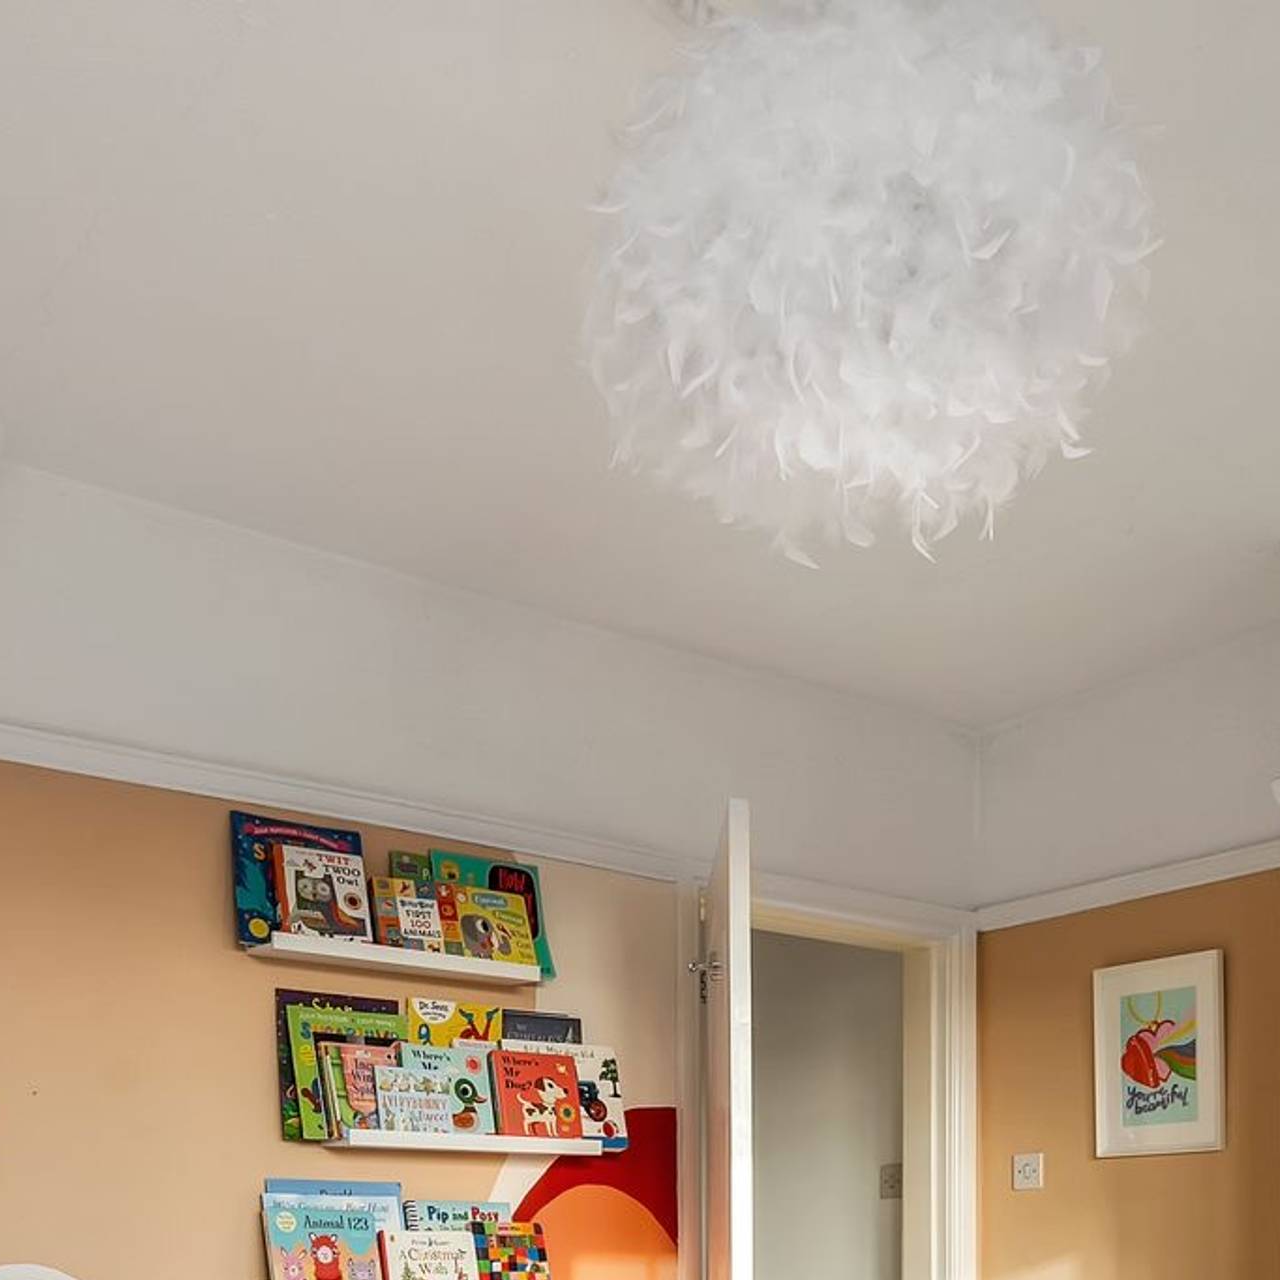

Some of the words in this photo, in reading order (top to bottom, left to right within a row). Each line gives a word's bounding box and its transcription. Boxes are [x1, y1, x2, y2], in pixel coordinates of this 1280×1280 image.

[323, 864, 361, 877] TWOO
[336, 876, 359, 887] Owl
[405, 909, 432, 920] FIRST
[410, 919, 432, 929] 100
[403, 927, 442, 939] ANIMALS
[411, 1049, 451, 1061] Where's
[501, 1055, 539, 1067] Where's
[504, 1066, 521, 1078] Mr
[505, 1079, 533, 1092] Dog?
[1133, 1084, 1190, 1115] beautiful
[426, 1205, 450, 1224] Pip
[452, 1209, 469, 1221] and
[471, 1206, 499, 1221] Posy
[304, 1215, 345, 1230] Animal
[347, 1217, 370, 1231] 123
